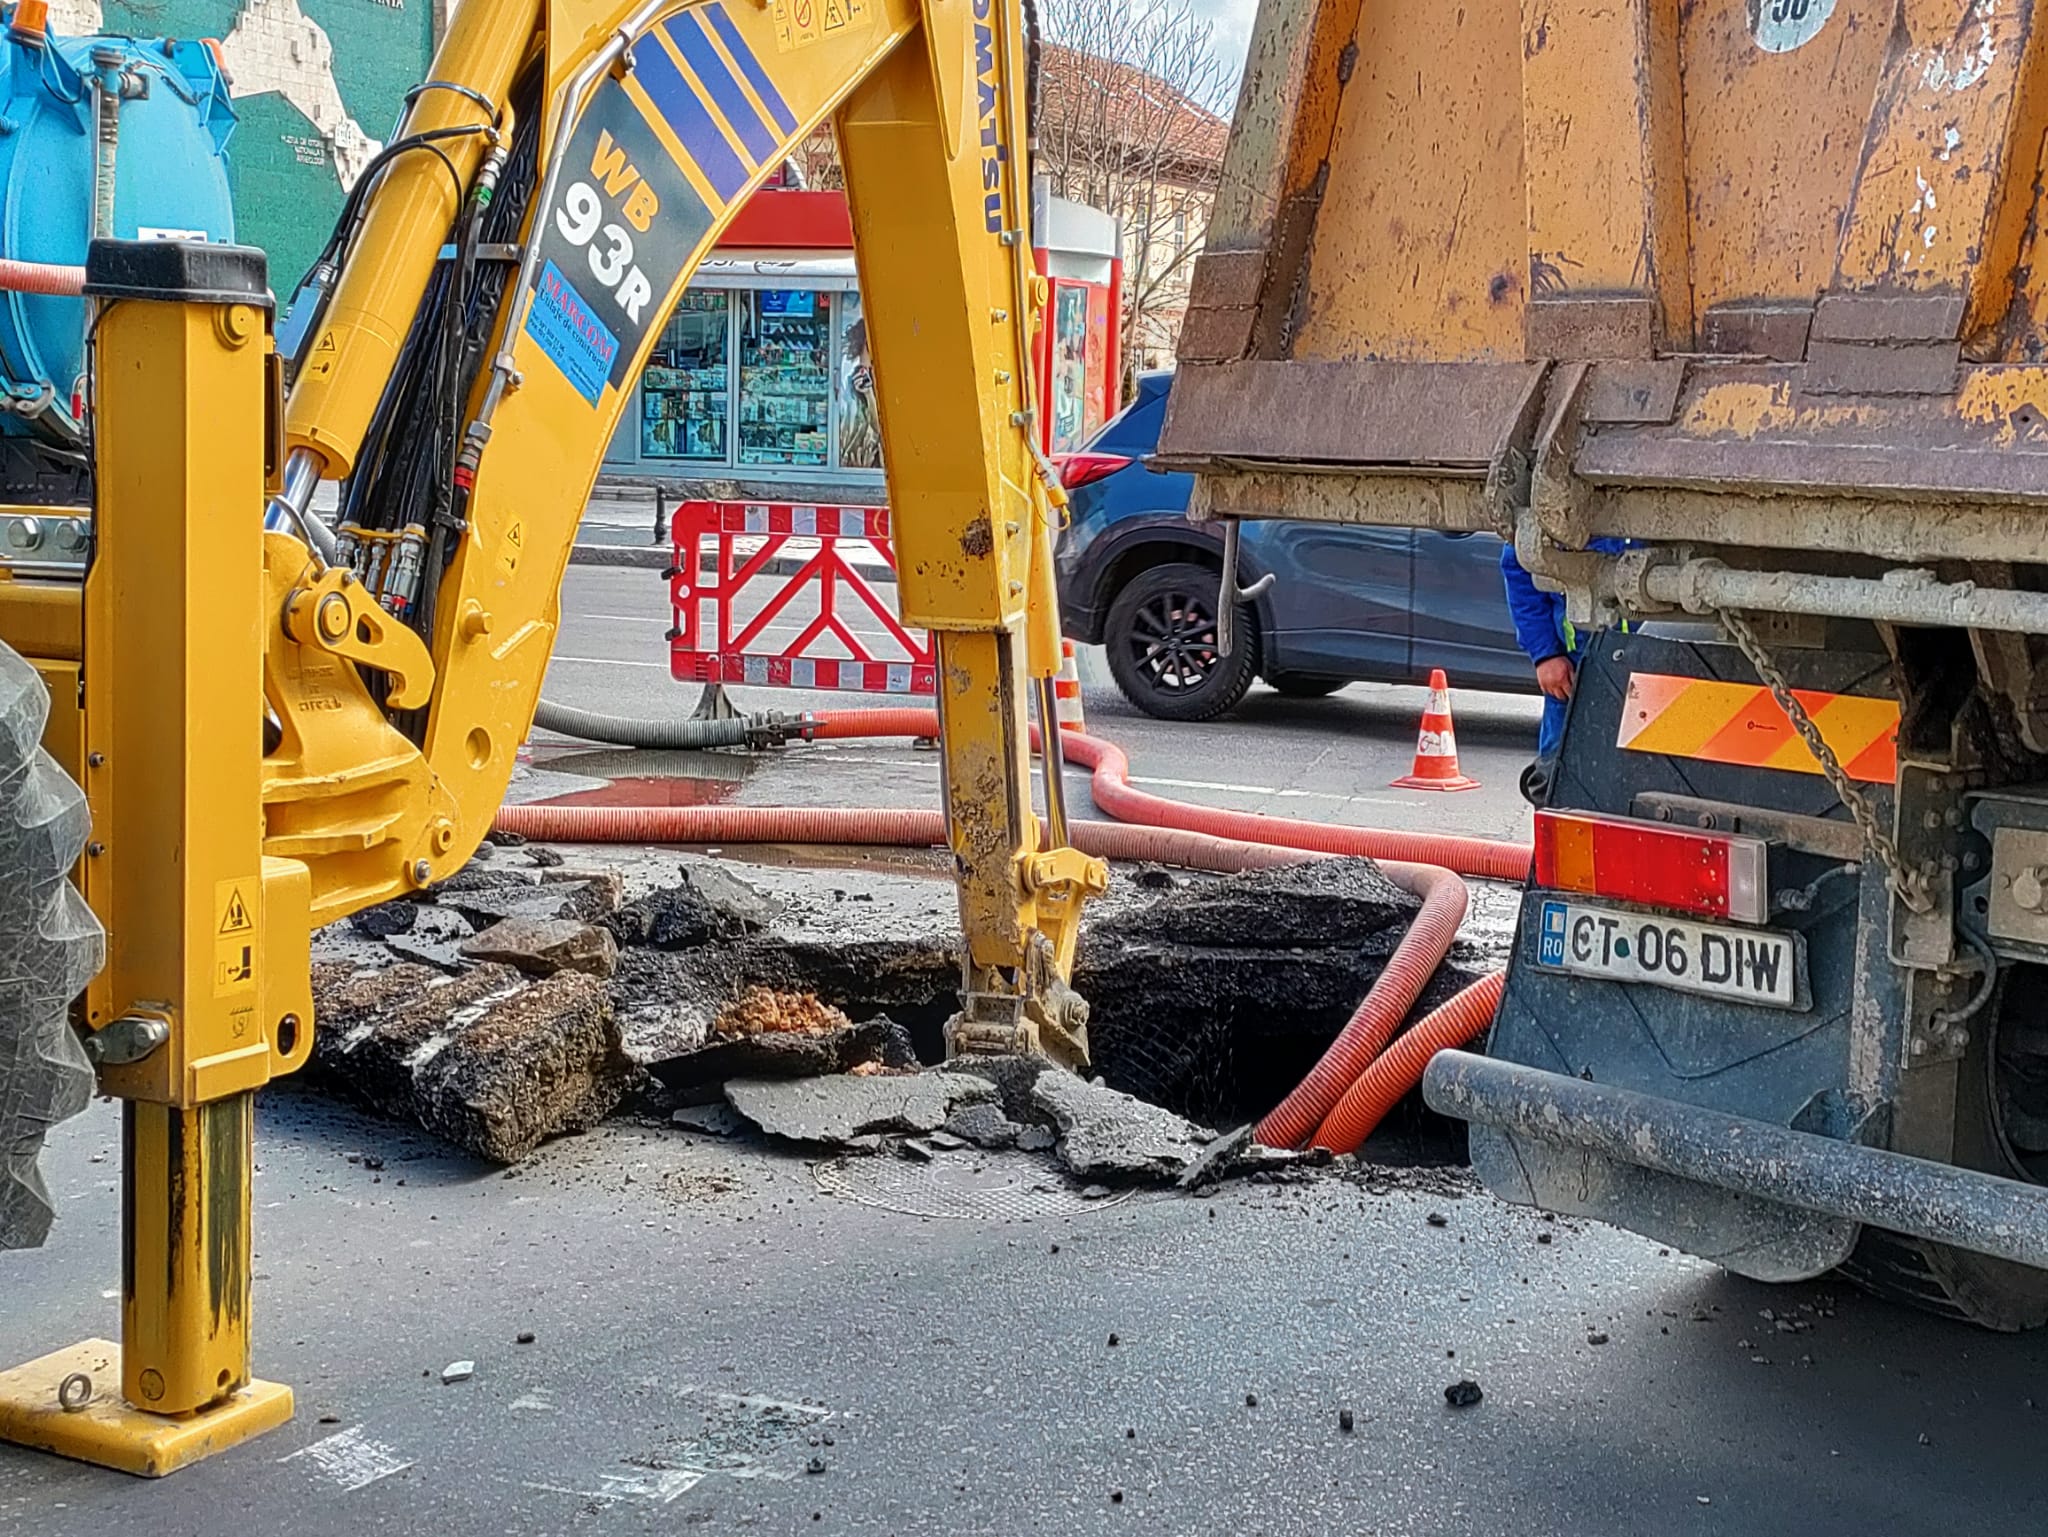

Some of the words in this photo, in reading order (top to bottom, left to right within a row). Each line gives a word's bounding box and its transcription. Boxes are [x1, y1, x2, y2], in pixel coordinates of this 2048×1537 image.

[590, 128, 659, 232] WB
[556, 182, 652, 326] 93R
[544, 272, 613, 362] MARCOM
[1543, 938, 1563, 958] RO
[1572, 915, 1619, 966] CT
[1637, 924, 1688, 976] 06
[1701, 933, 1781, 993] DIW
